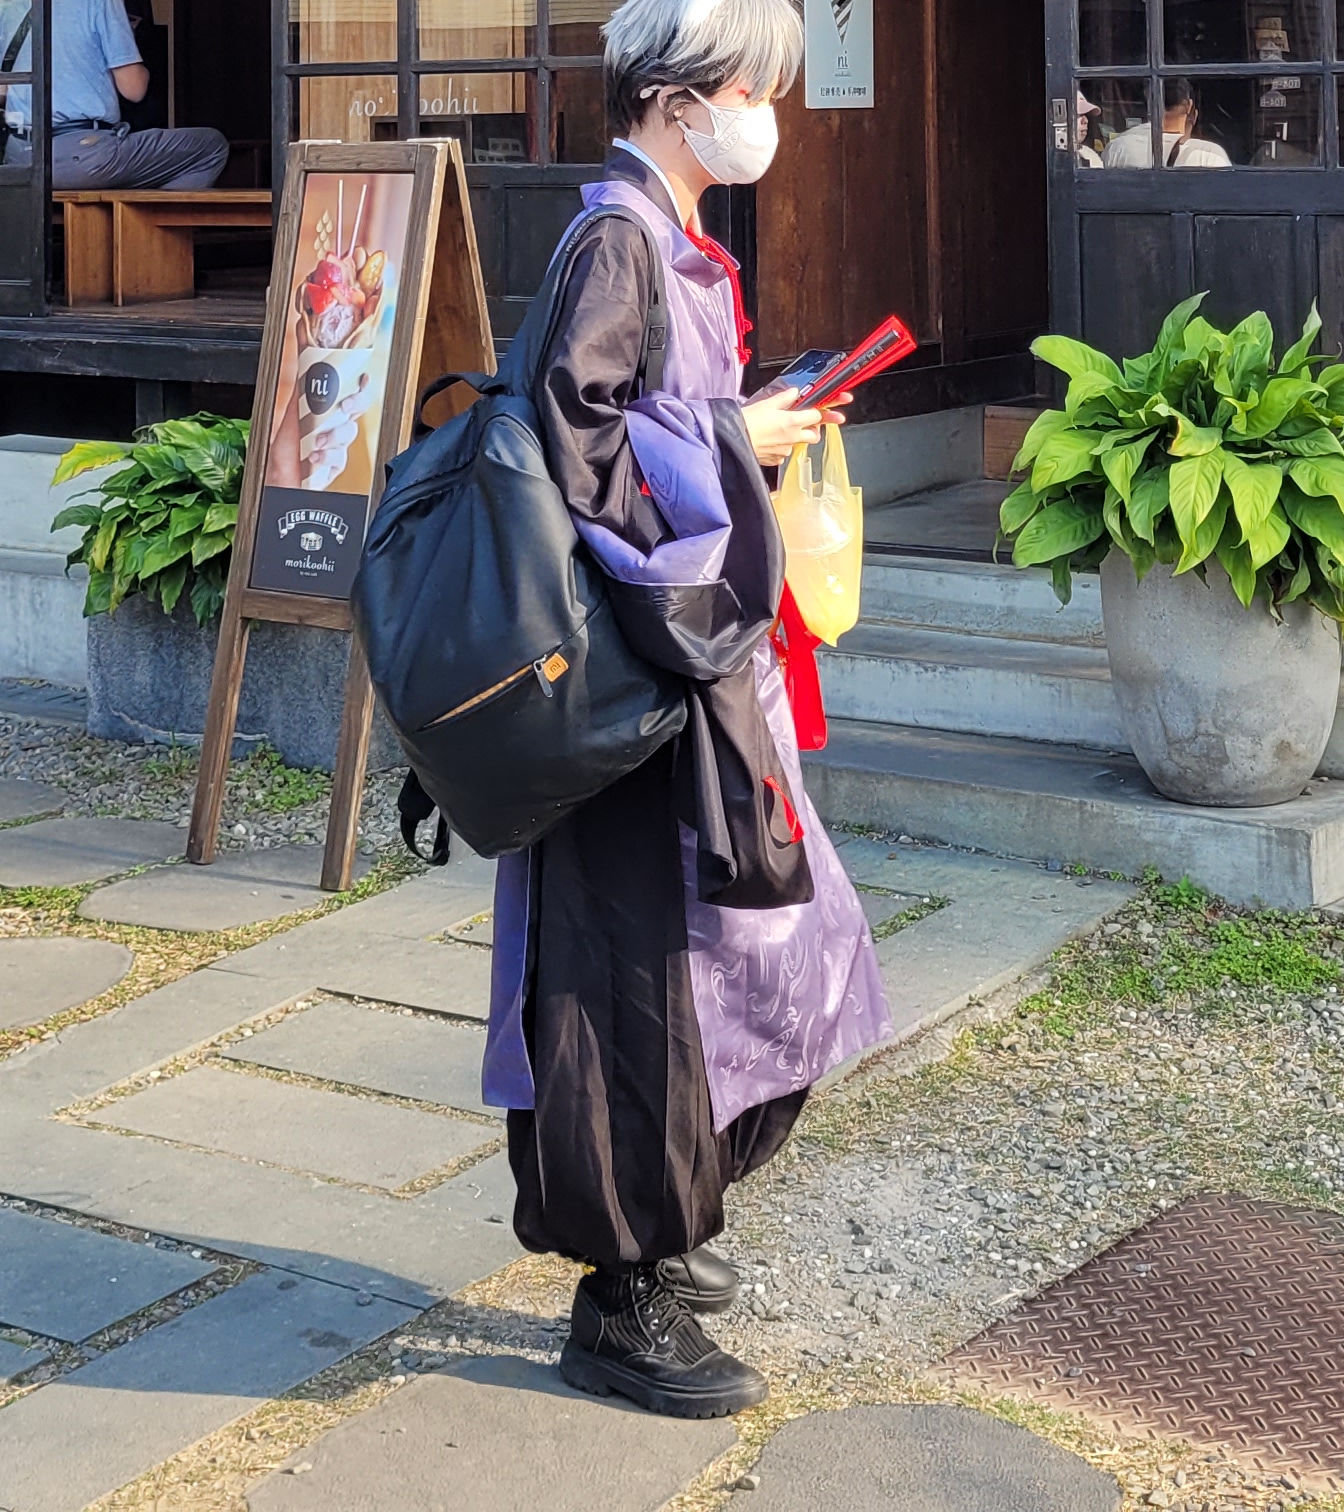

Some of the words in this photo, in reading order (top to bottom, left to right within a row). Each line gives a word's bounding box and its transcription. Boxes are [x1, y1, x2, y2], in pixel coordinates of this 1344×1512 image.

[310, 373, 329, 396] ni
[290, 511, 306, 523] EGG
[308, 511, 338, 527] WAFFLE
[284, 554, 336, 572] morikoohii
